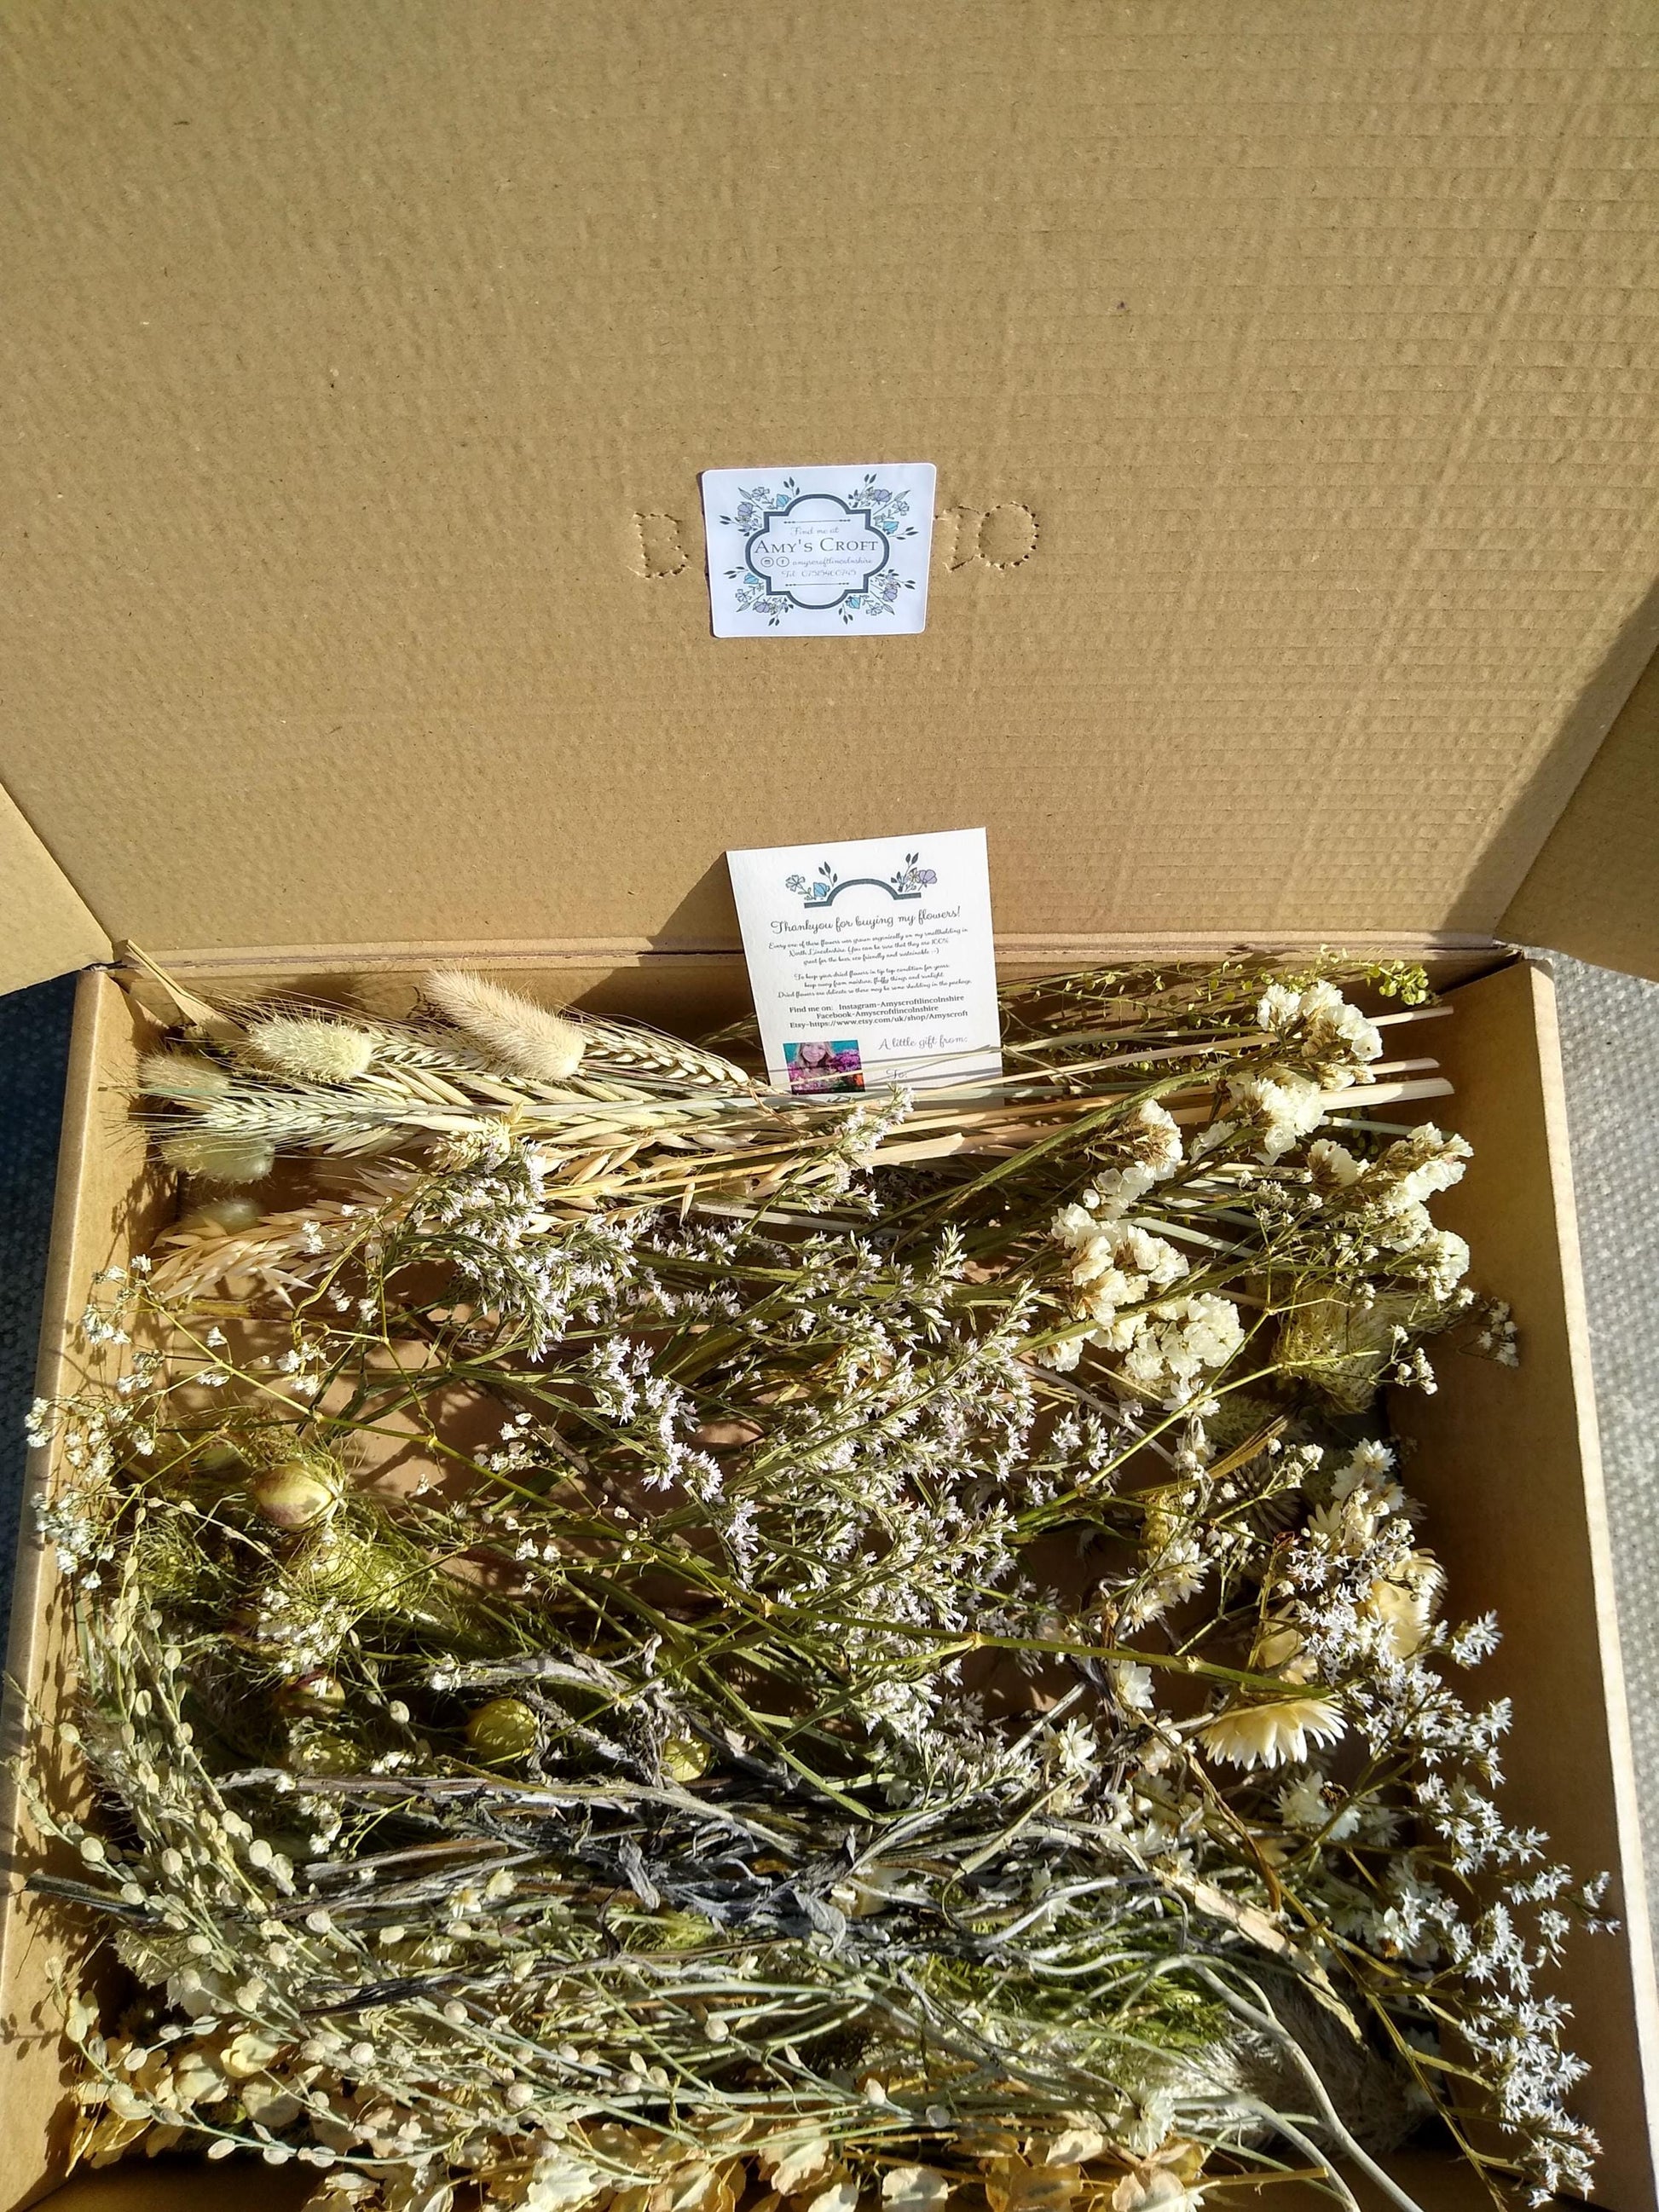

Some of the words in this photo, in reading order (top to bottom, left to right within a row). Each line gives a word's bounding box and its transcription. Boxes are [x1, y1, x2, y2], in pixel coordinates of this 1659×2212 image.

[790, 527, 813, 535] Find
[770, 919, 833, 934] Thankyou
[835, 916, 853, 933] for
[855, 915, 893, 930] buying
[898, 915, 916, 927] my
[918, 905, 961, 926] flowers!
[872, 933, 904, 942] organically
[863, 952, 885, 962] friendly
[899, 948, 929, 956] sustainable
[839, 995, 965, 1011] Instagram-Amyscroftlincolnshire
[816, 1005, 939, 1019] Facebook-Amyscroftlincolnshire
[789, 1011, 968, 1029] Etsy-https://www.etsy.com/uk/shop/Amyscroft
[878, 1037, 891, 1050] A
[892, 1037, 917, 1048] little
[918, 1035, 936, 1048] gift
[939, 1034, 968, 1048] from:
[886, 1068, 908, 1079] To:
